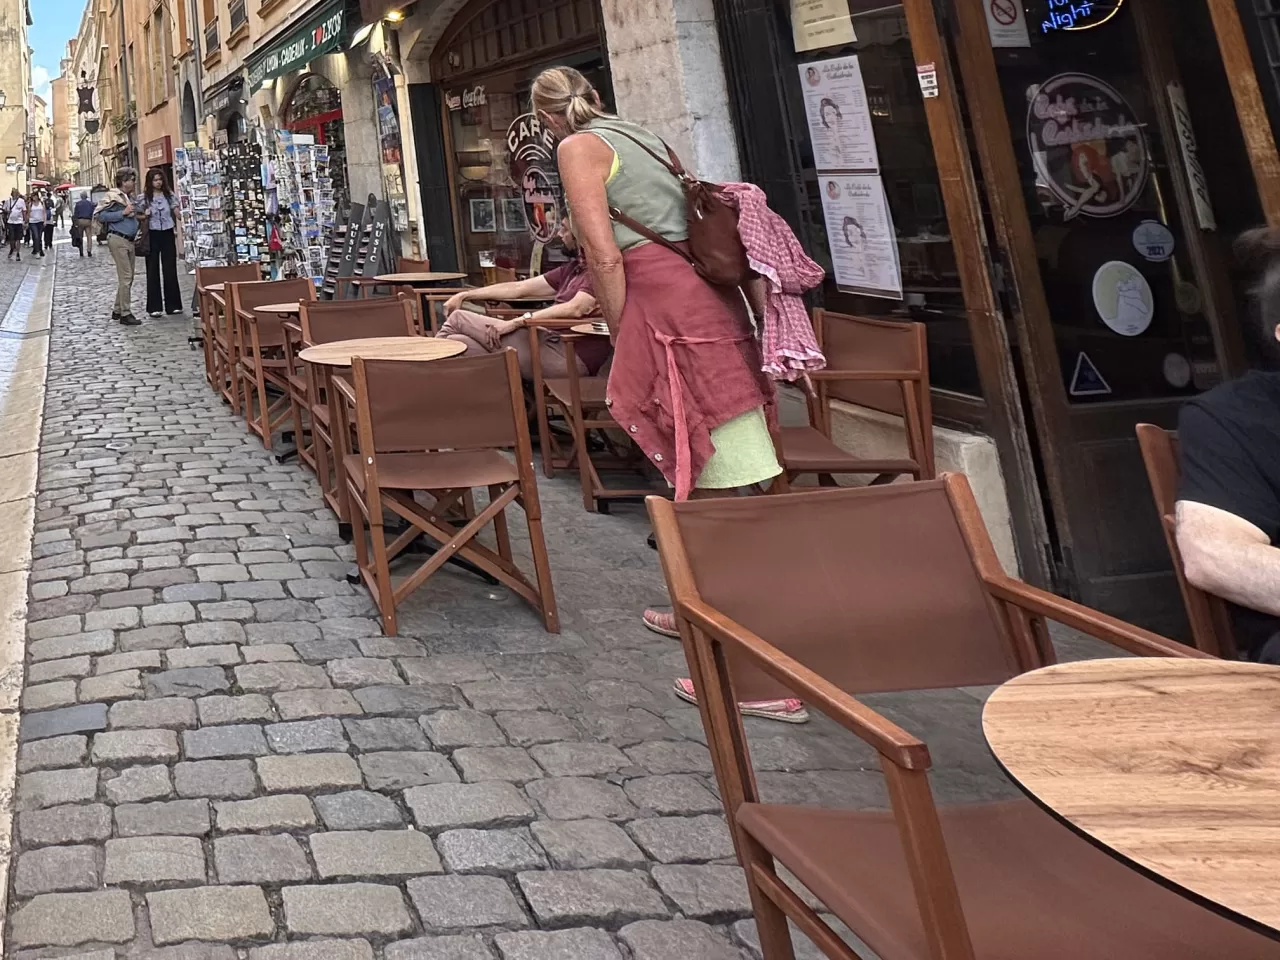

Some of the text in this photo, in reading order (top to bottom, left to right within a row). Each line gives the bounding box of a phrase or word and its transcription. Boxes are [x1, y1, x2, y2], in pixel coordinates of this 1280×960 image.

[1041, 1, 1094, 33] Night
[281, 38, 305, 66] CADEAUX
[322, 10, 343, 43] LYON
[345, 223, 359, 261] MUSIC
[369, 221, 385, 262] MUSIC
